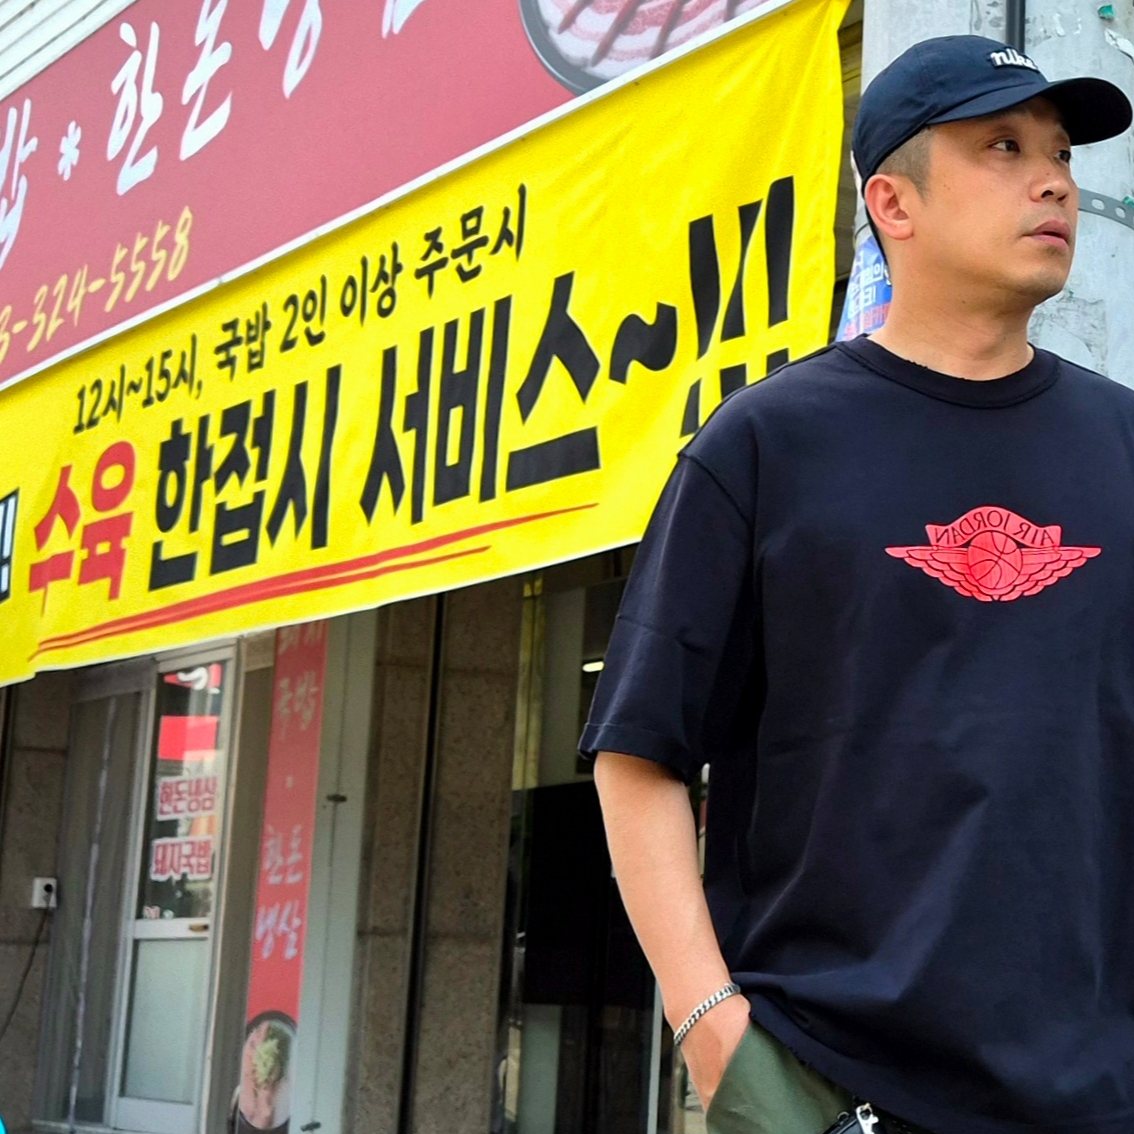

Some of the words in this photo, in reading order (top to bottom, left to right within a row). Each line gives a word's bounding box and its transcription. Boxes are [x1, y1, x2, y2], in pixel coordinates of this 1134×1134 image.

[214, 301, 272, 381] 국밥
[279, 274, 328, 353] 2인
[340, 242, 404, 327] 이상
[415, 183, 528, 299] 주문시
[29, 440, 136, 617] 수육
[148, 363, 342, 592] 한접시
[153, 839, 212, 876] 돼지국밥
